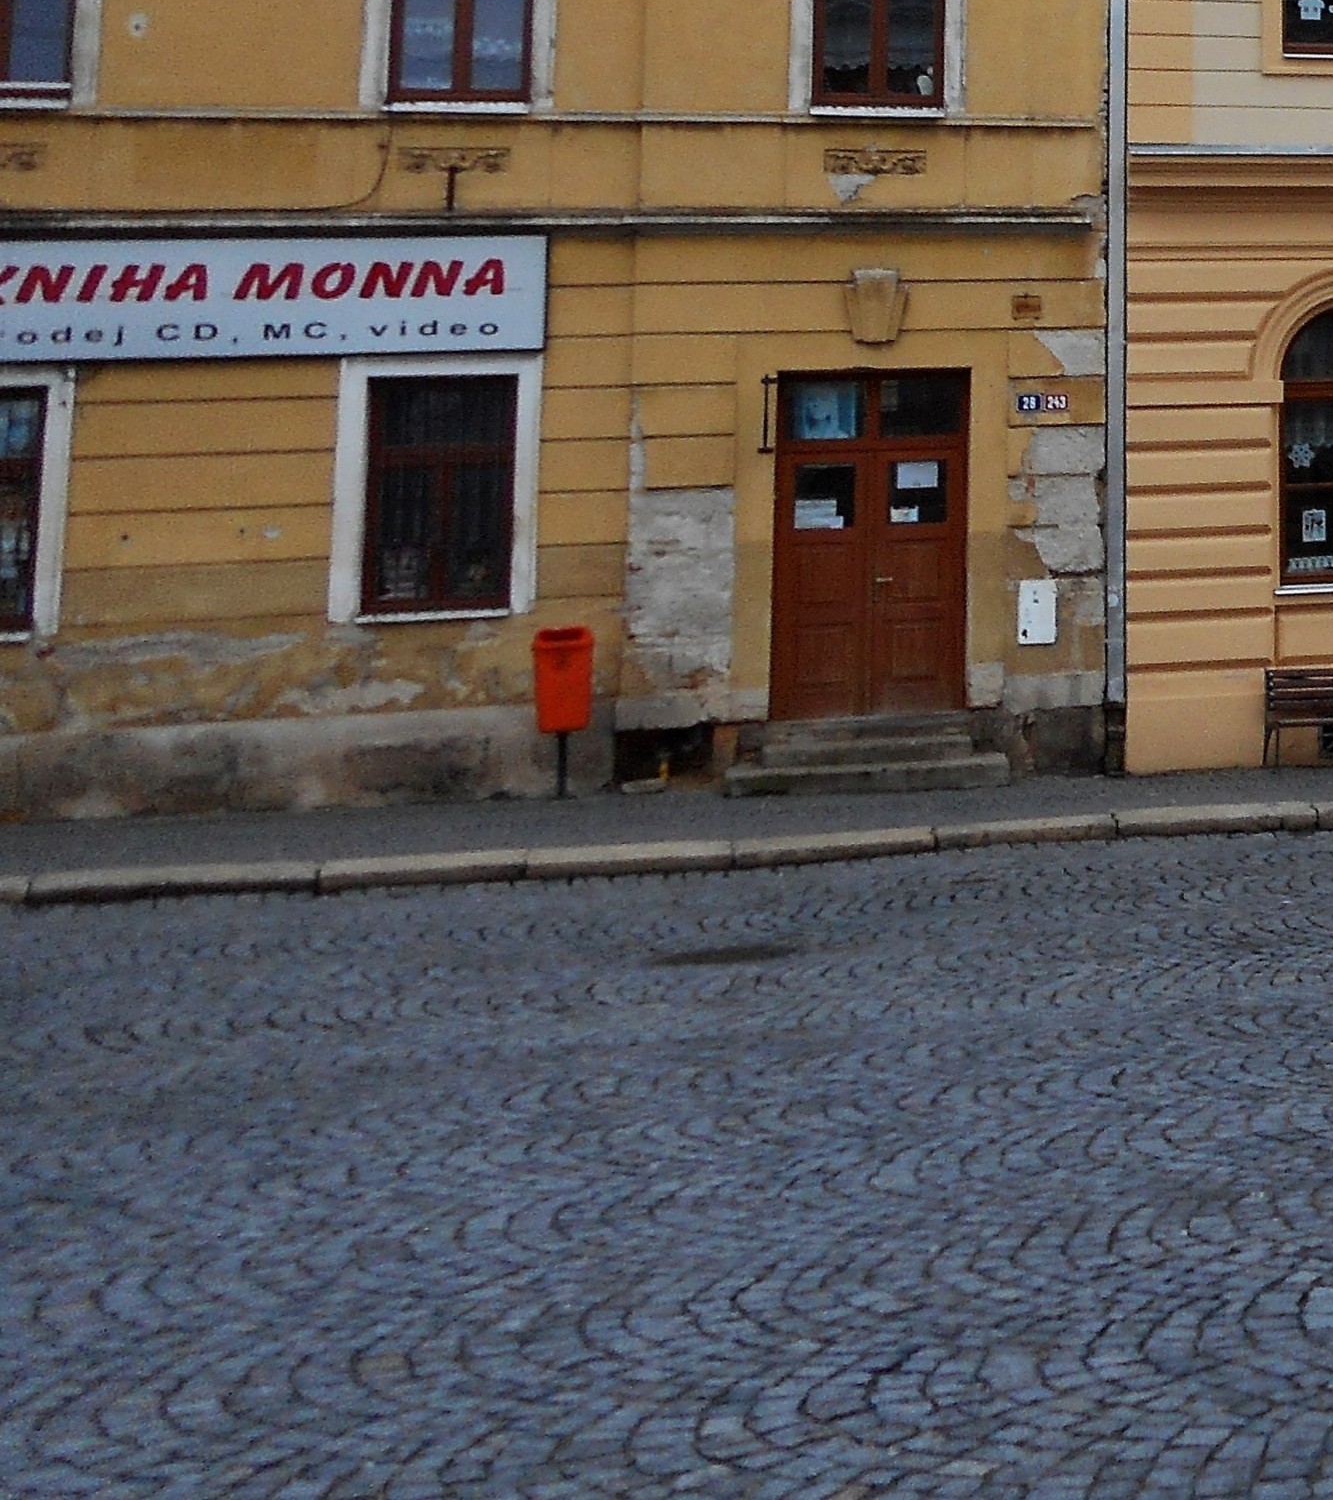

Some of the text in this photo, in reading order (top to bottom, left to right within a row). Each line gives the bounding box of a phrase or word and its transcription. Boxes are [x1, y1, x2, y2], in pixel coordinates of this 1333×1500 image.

[233, 258, 506, 301] MONNA
[0, 325, 125, 347] odej
[262, 321, 347, 341] MC,
[369, 319, 500, 338] video
[1046, 395, 1067, 410] 243
